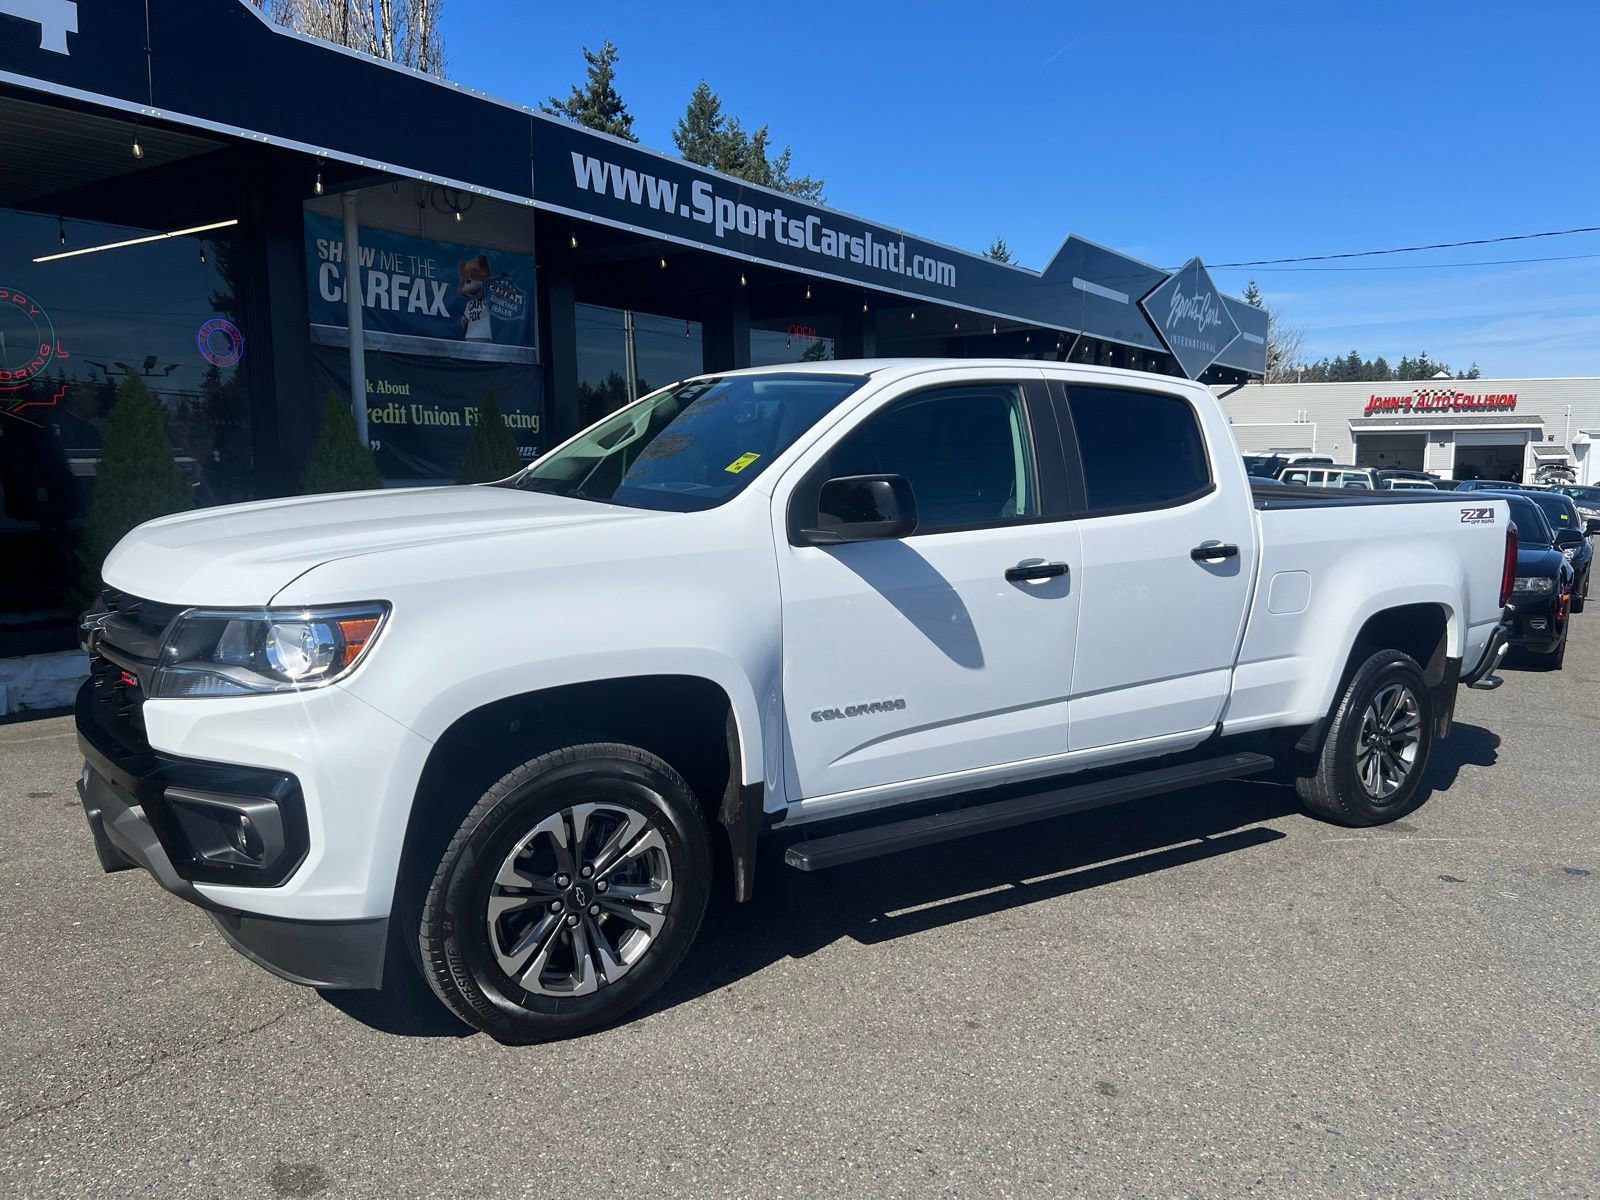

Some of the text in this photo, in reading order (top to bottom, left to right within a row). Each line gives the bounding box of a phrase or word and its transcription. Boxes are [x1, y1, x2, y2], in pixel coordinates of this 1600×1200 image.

[571, 152, 956, 288] www.SportsCarsIntl.com
[317, 239, 436, 278] SHW ME THE
[789, 324, 816, 342] OPEN
[1170, 334, 1216, 353] INTERNATIONAL
[376, 380, 410, 395] About
[1414, 393, 1450, 409] AUTO
[1453, 393, 1517, 411] COLLISION
[411, 404, 461, 426] Union
[464, 407, 540, 433] Fincing
[1461, 508, 1494, 523] Z71
[810, 698, 907, 722] COLORADO
